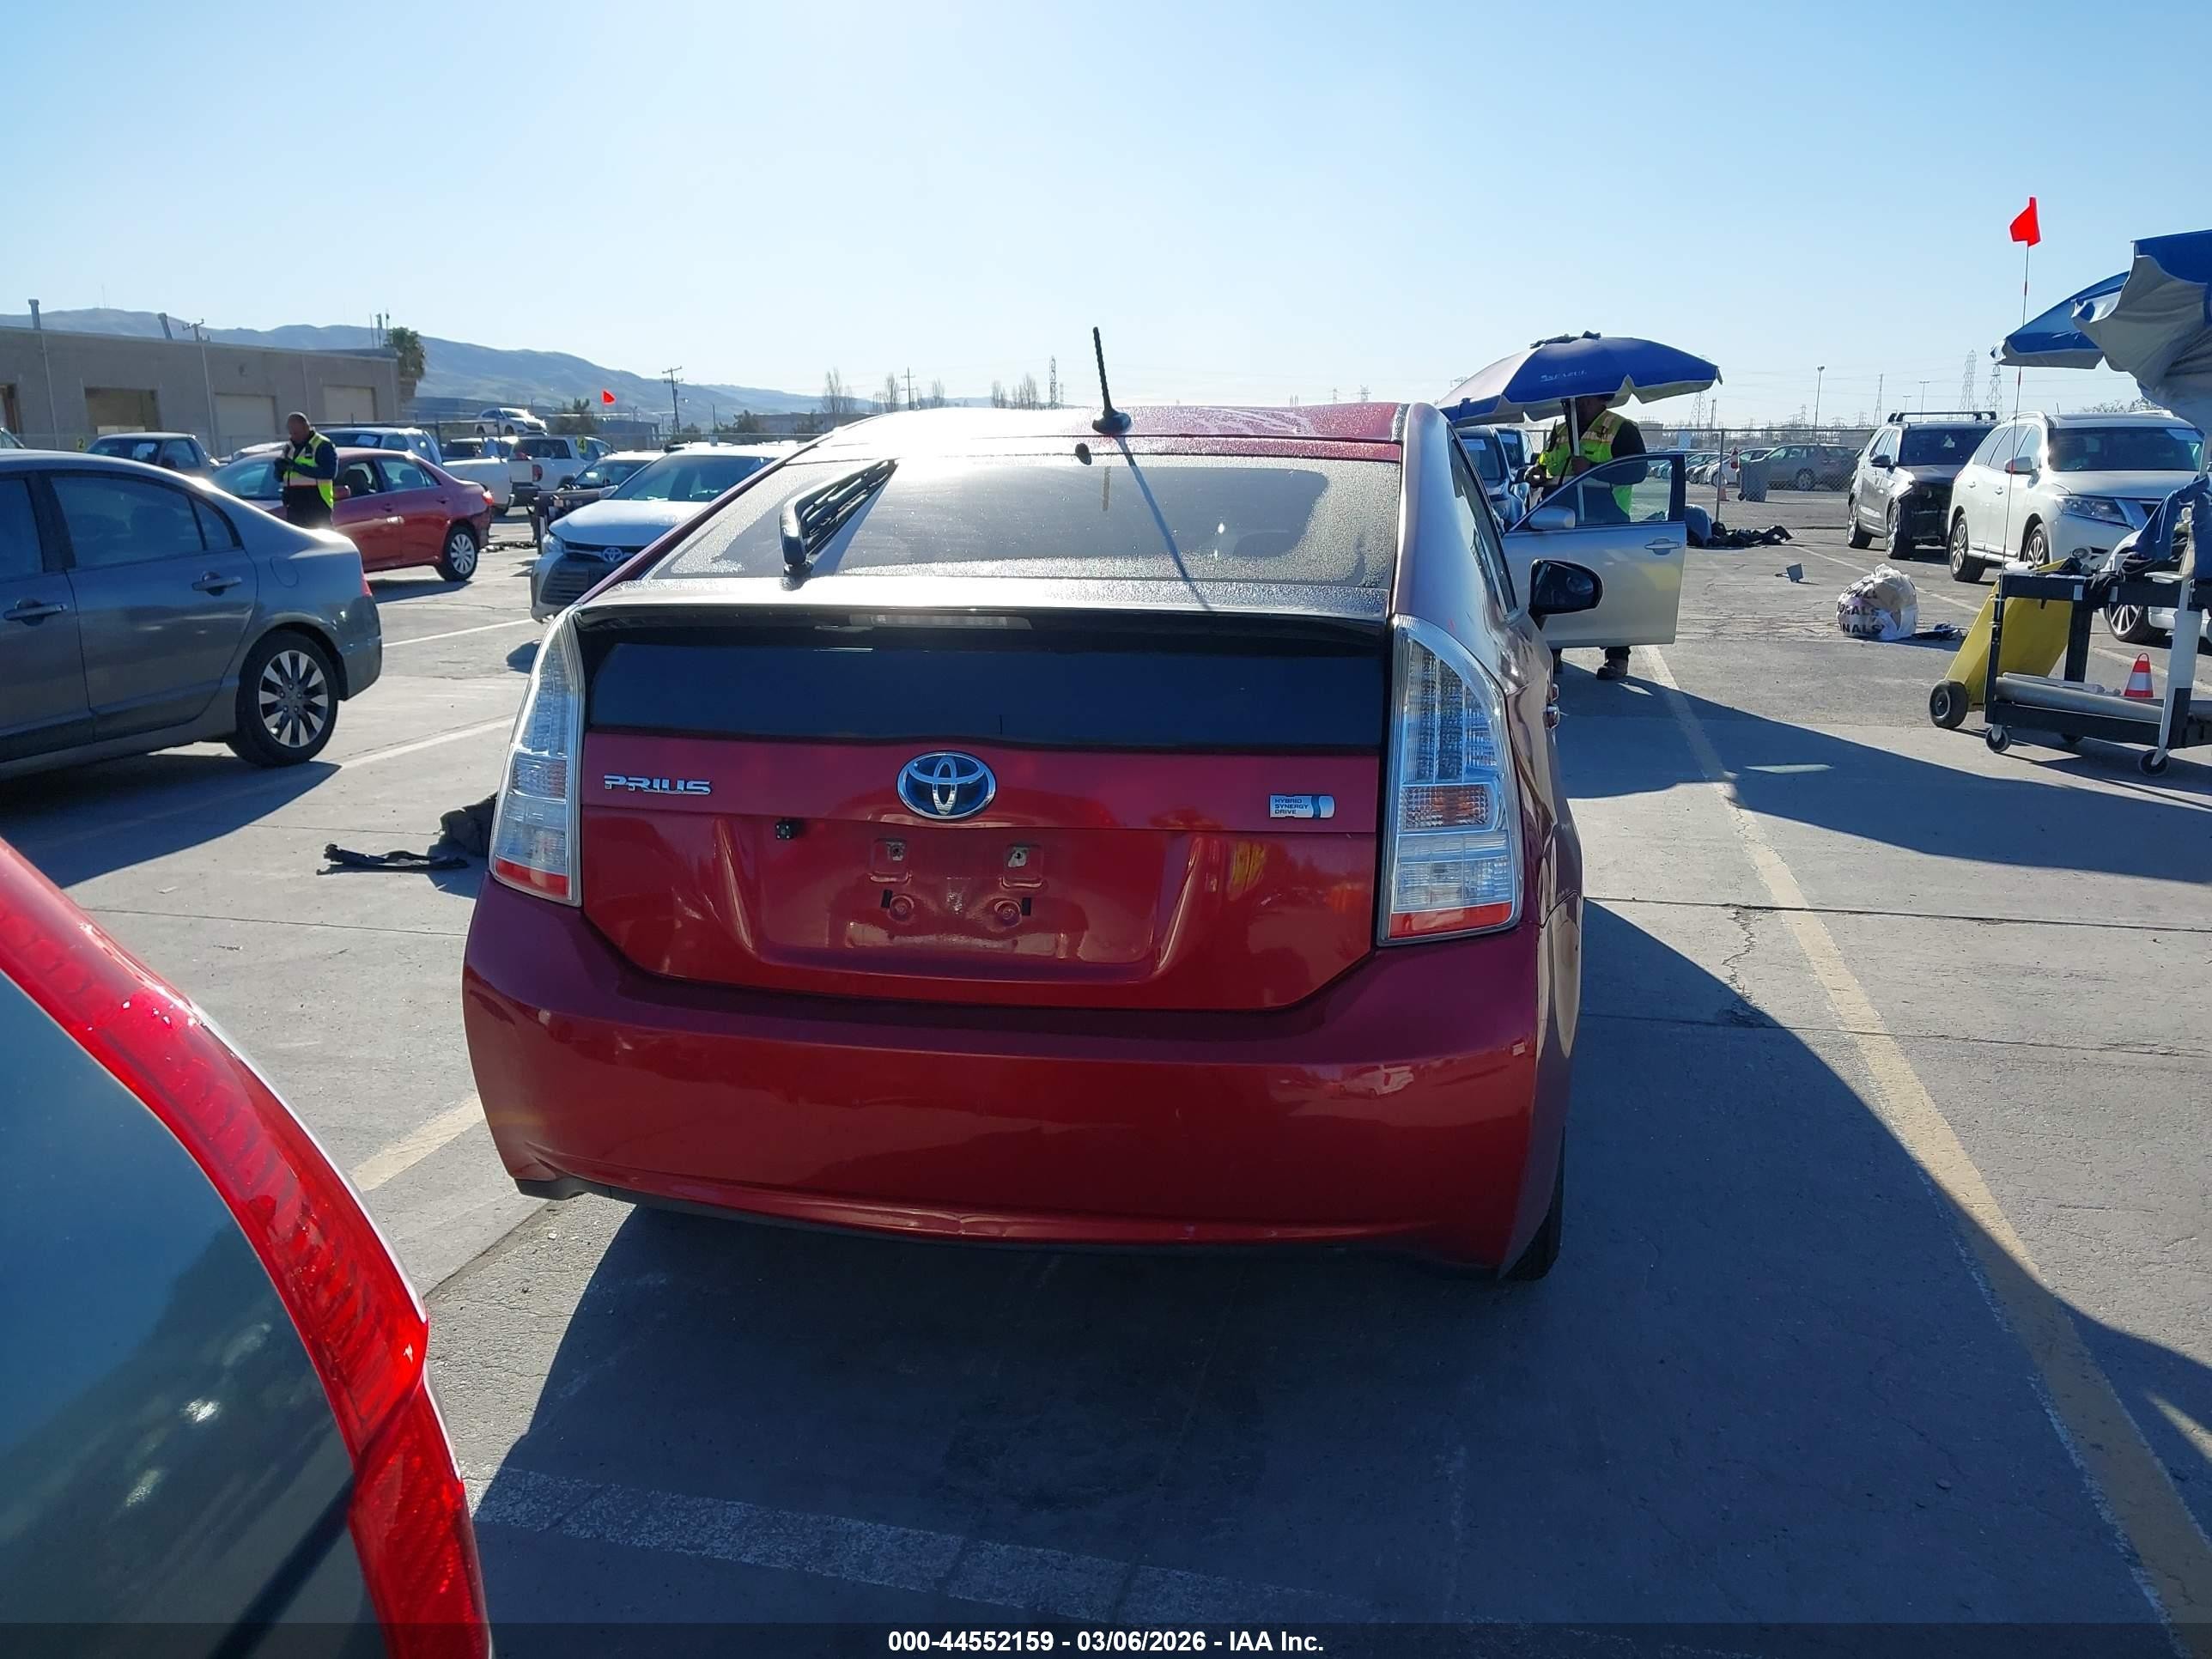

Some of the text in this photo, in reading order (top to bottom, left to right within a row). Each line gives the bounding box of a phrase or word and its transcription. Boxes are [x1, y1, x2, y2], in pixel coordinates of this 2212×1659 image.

[78, 438, 84, 448] 2
[578, 439, 585, 451] 4
[604, 775, 711, 795] PRIUS
